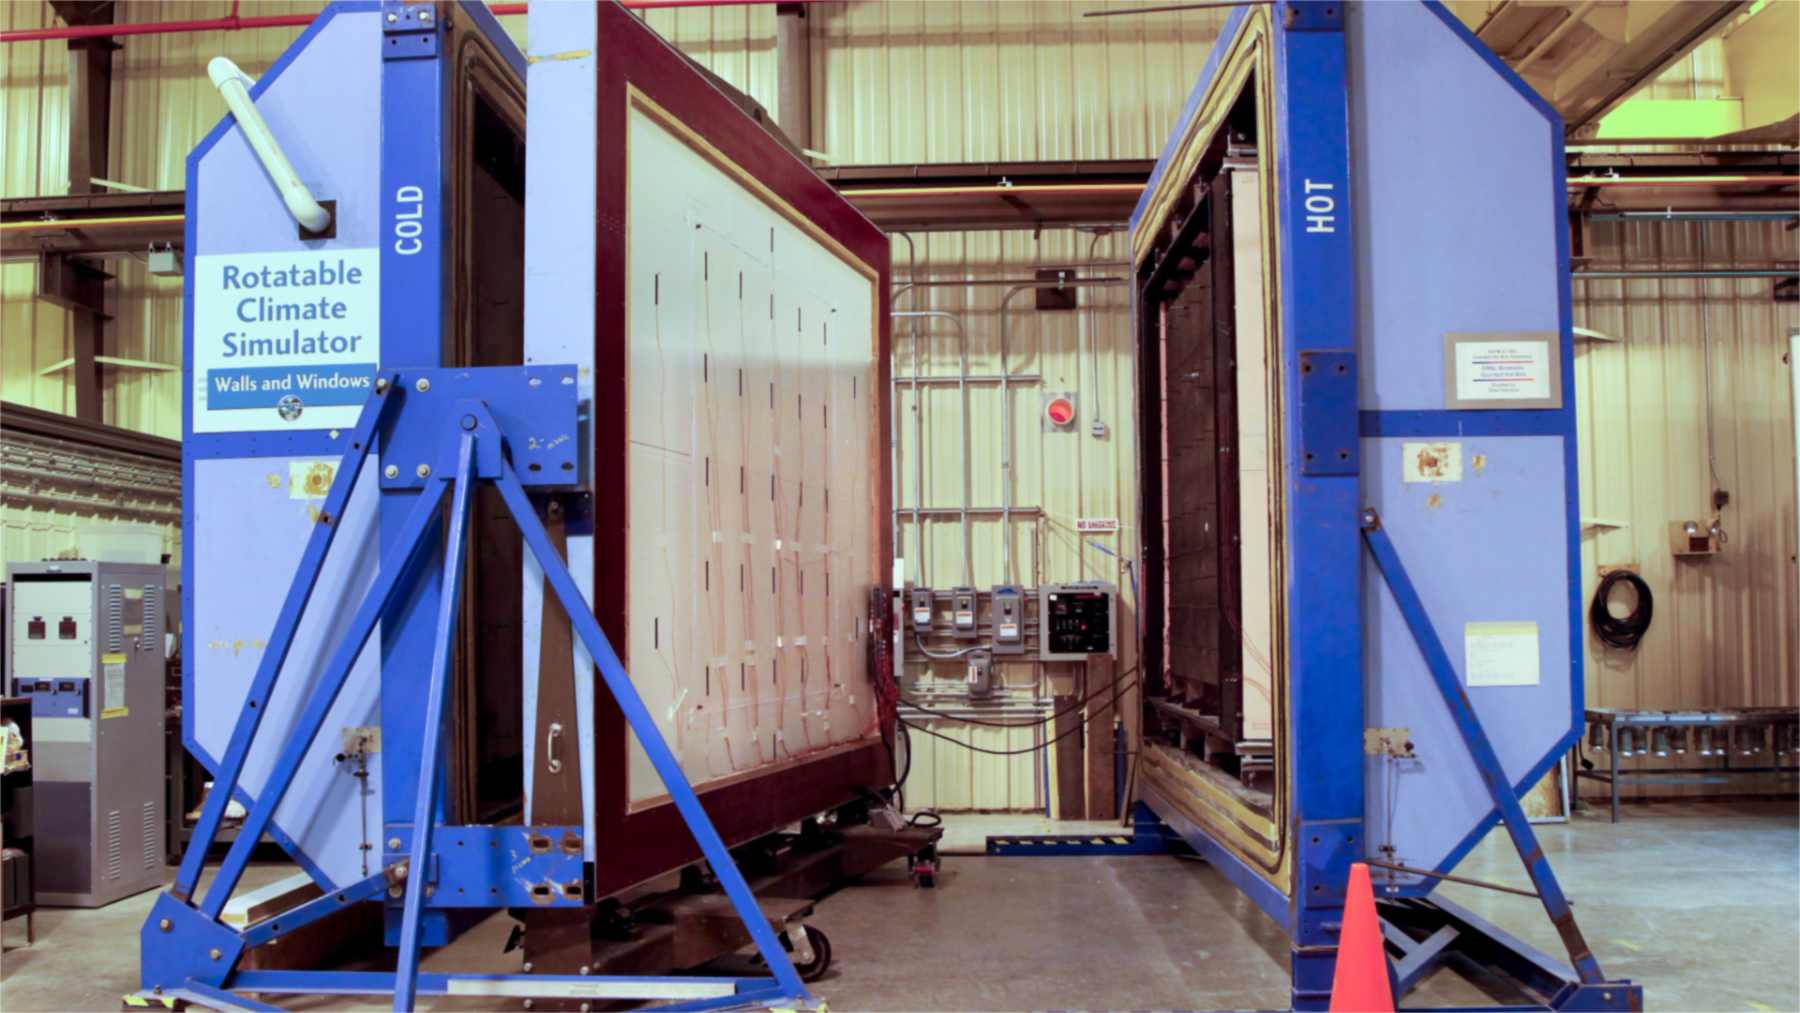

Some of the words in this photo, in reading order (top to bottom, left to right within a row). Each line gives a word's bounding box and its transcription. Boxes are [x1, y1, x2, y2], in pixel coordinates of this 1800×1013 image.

[394, 185, 423, 255] COLD
[1304, 178, 1335, 233] HOT
[222, 259, 363, 290] Rotatable
[236, 296, 347, 323] Climate
[222, 328, 363, 358] Simulator
[215, 375, 257, 393] Walls
[261, 374, 291, 391] and
[296, 372, 371, 390] Windows
